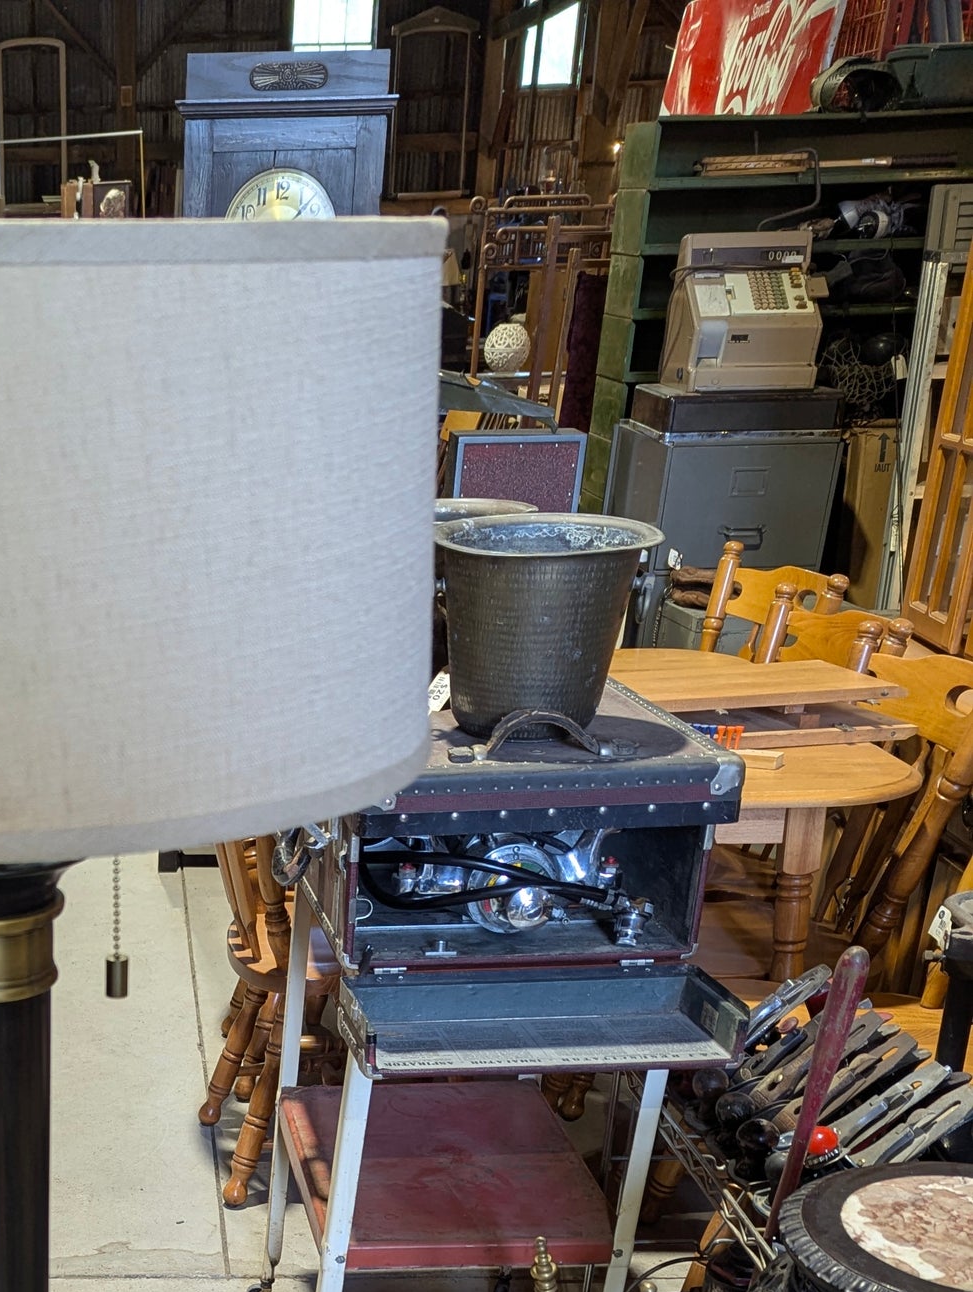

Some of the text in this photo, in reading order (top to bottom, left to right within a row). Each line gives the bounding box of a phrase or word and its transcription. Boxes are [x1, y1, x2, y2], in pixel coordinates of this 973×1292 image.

[257, 187, 267, 206] 11
[275, 180, 291, 200] 12
[432, 684, 448, 700] $20
